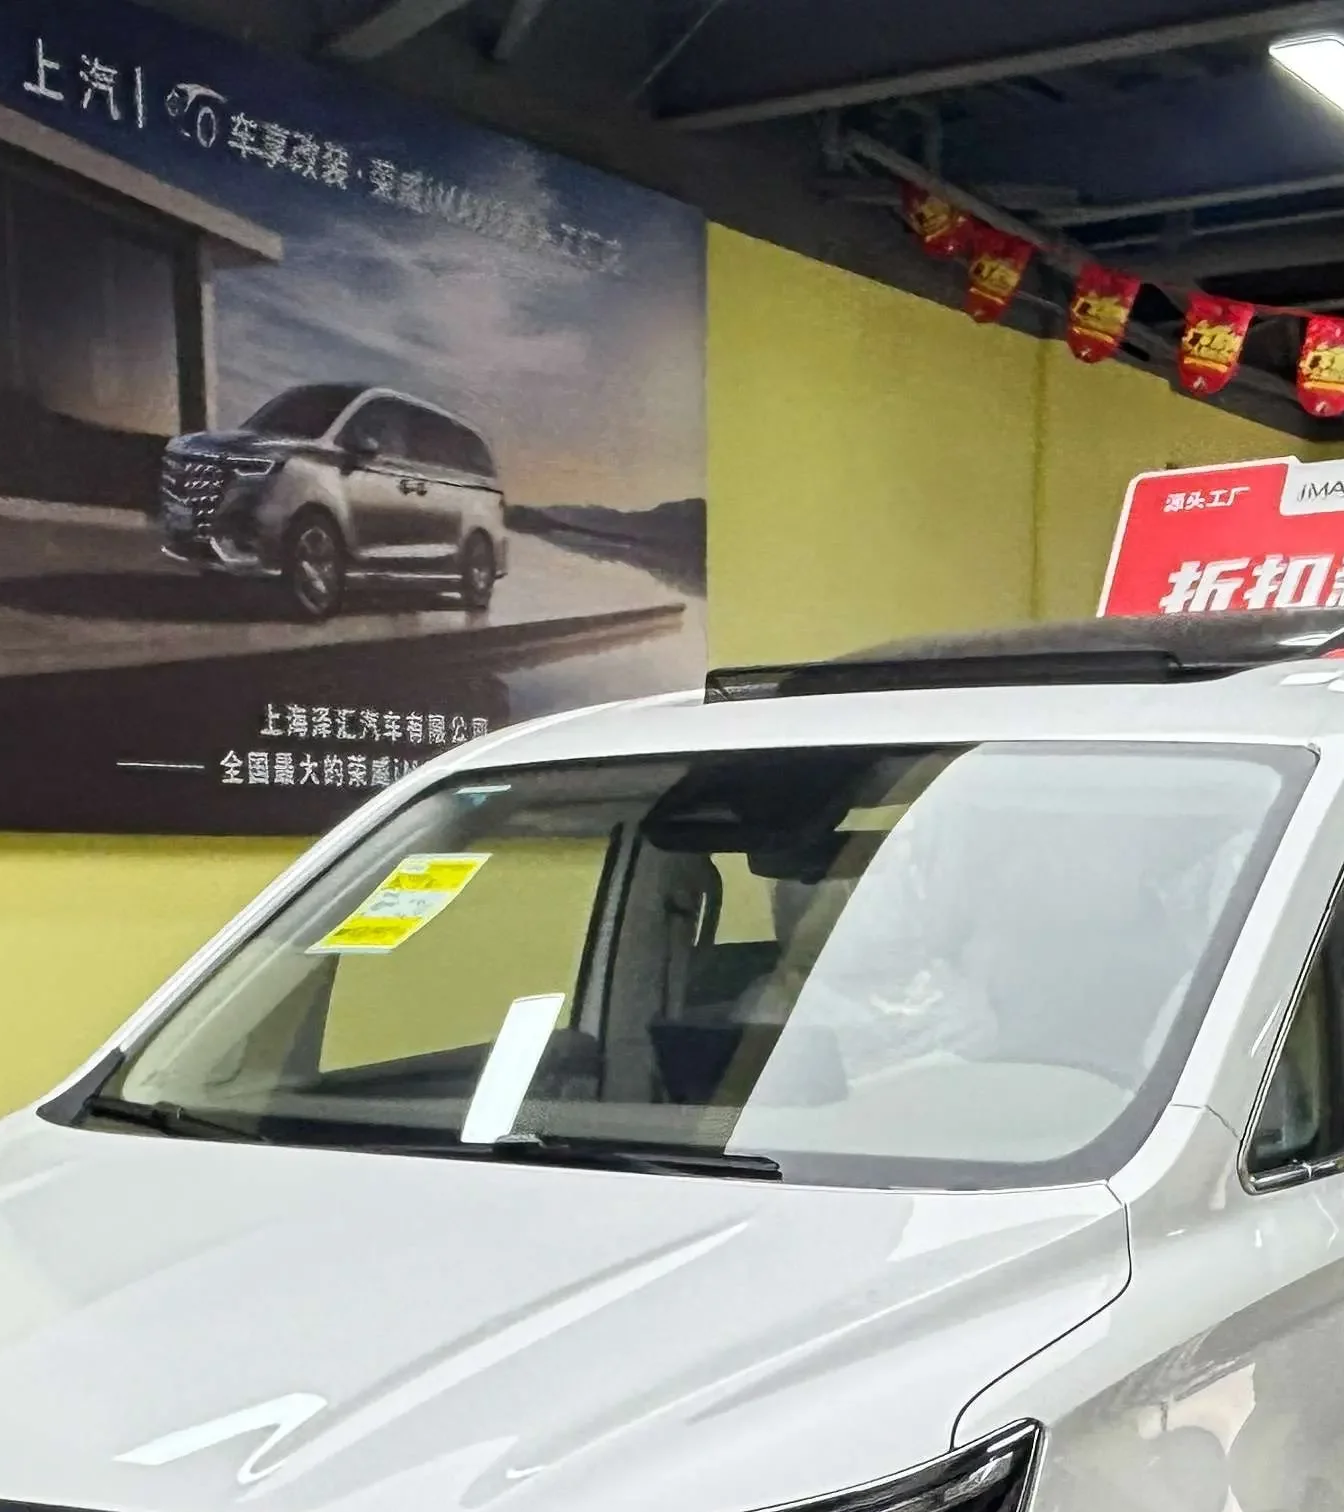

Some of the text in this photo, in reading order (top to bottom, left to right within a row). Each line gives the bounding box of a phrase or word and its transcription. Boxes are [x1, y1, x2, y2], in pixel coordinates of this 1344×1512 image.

[23, 38, 120, 120] 上汽
[259, 703, 489, 743] 上海泽汇汽车有限公司
